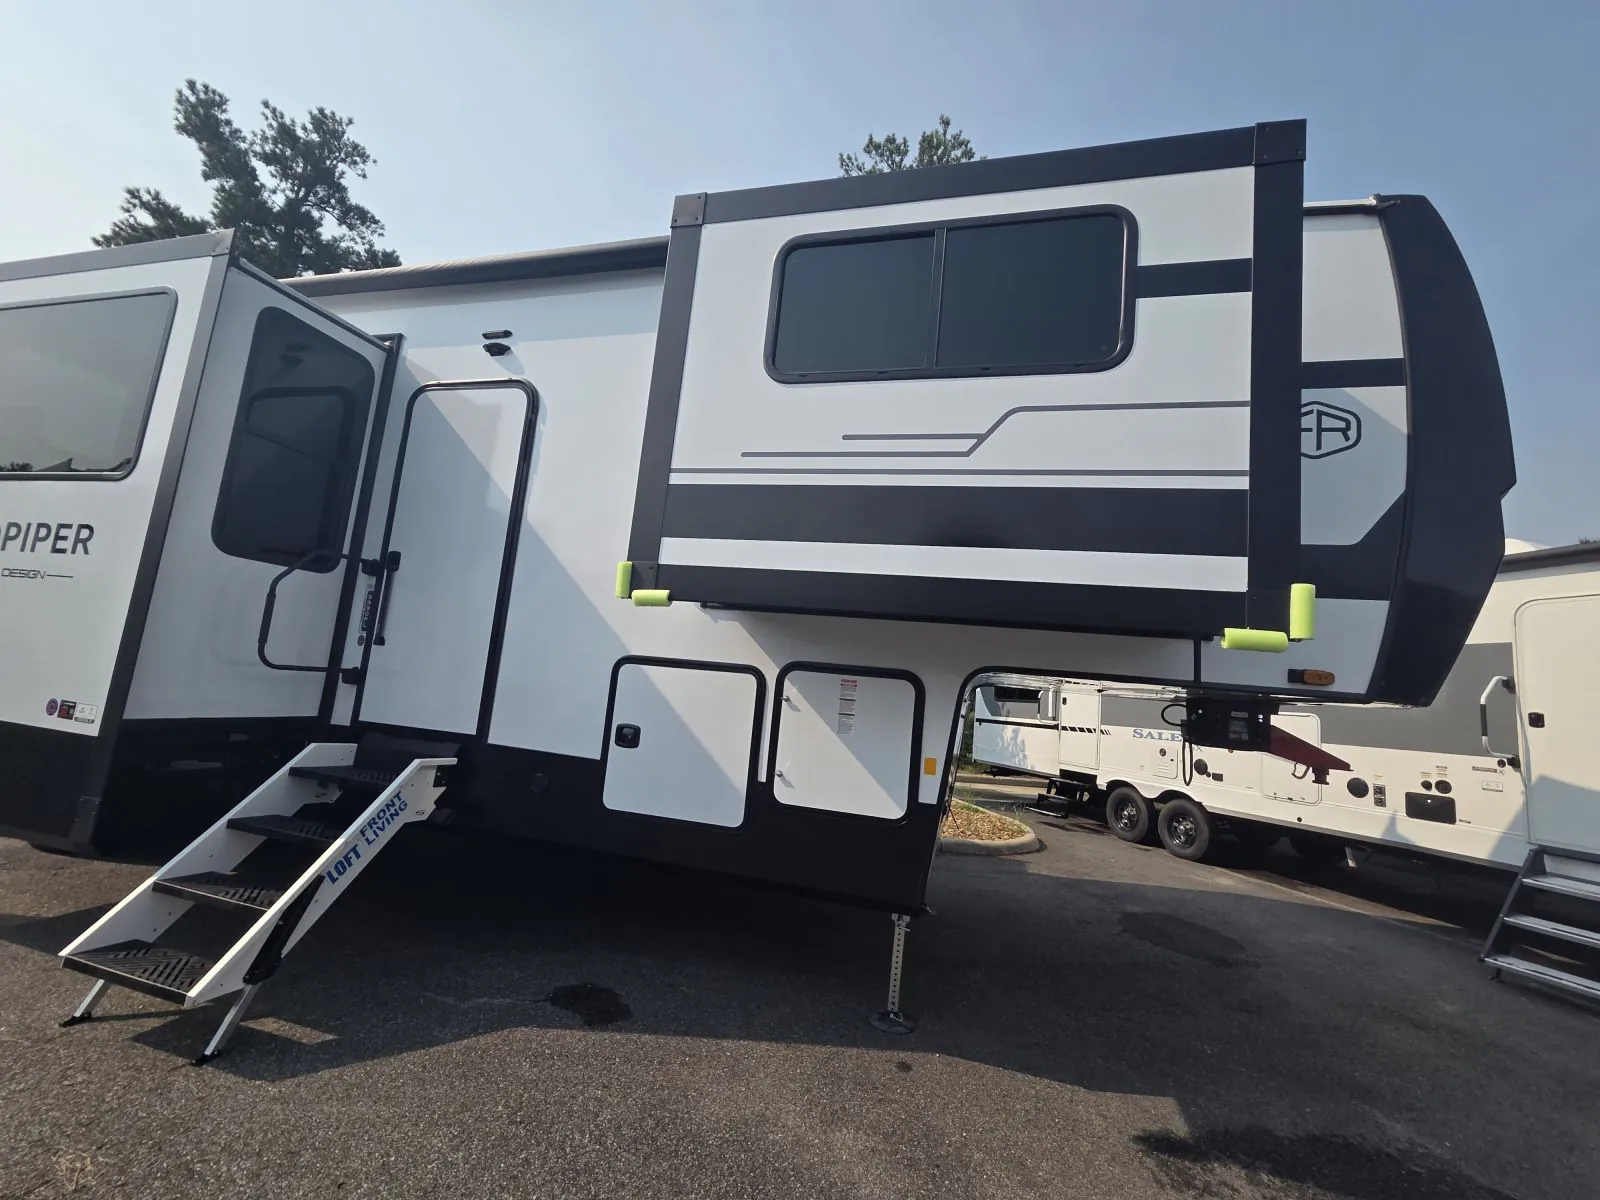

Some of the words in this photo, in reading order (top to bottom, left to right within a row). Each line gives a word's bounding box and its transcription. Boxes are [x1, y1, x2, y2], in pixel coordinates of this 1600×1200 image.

[0, 522, 94, 555] PIPER
[1, 568, 46, 579] DESIGN
[1132, 728, 1183, 742] SALE
[360, 791, 402, 837] FRONT
[365, 801, 408, 845] LIVING
[326, 844, 361, 884] LOFT
